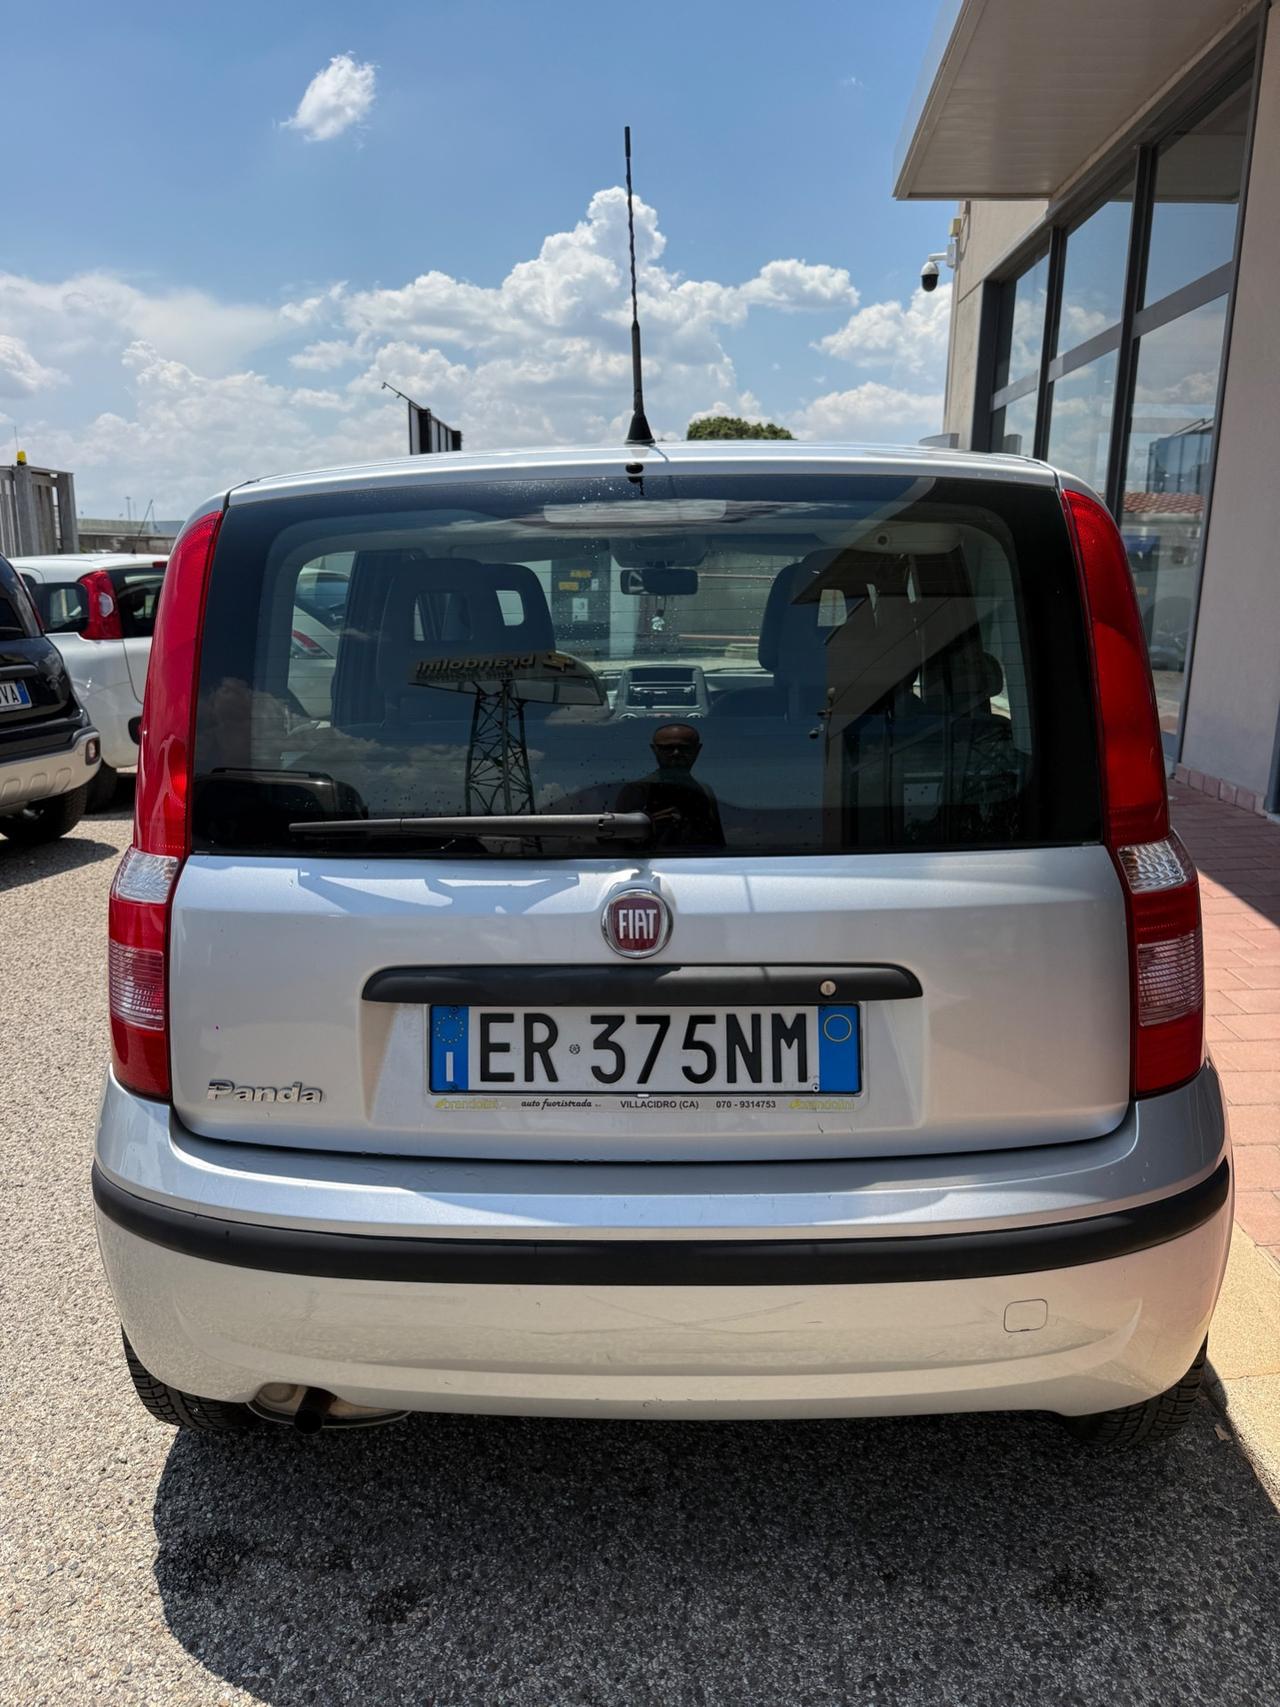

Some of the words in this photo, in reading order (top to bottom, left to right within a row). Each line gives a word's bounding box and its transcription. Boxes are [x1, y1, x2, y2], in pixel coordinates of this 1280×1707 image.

[0, 684, 20, 704] VA
[618, 908, 658, 940] FIAT
[480, 1013, 559, 1083] ER
[590, 1013, 808, 1085] 375NM
[207, 1079, 323, 1102] Panda
[541, 1098, 592, 1110] fuoristrada
[620, 1100, 677, 1109] VILLACIDRO
[679, 1100, 699, 1110] (CA)
[715, 1100, 732, 1109] 070
[739, 1100, 776, 1109] 9314753
